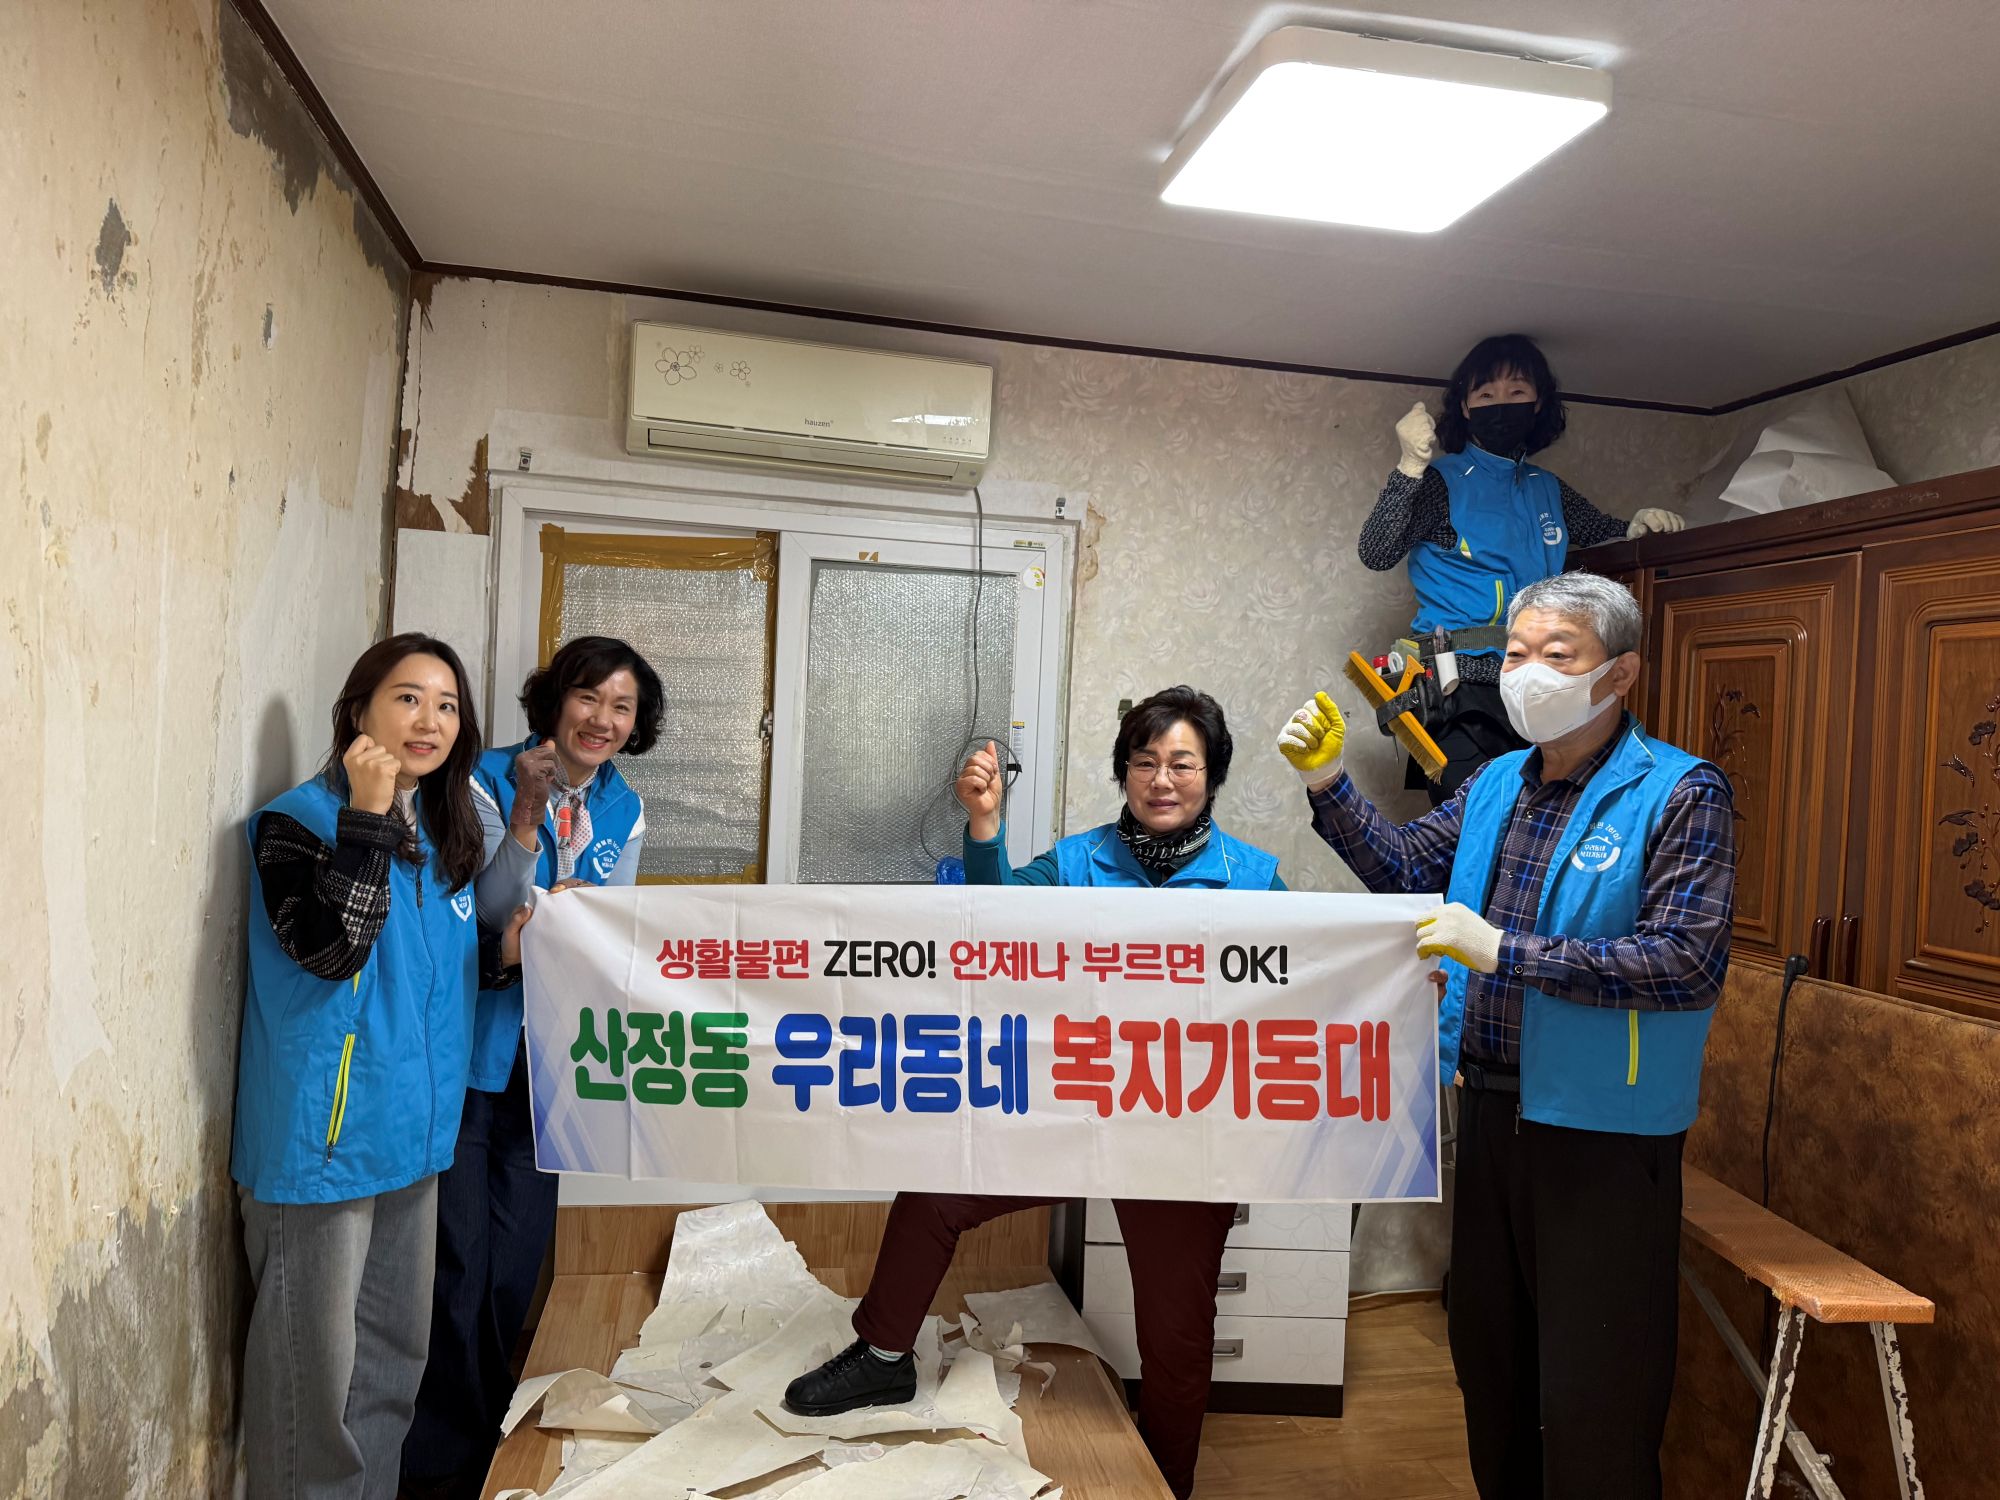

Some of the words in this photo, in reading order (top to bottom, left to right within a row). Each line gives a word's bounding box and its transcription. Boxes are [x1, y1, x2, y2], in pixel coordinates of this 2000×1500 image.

[656, 939, 809, 980] 생활불편
[823, 940, 936, 979] ZERO!
[949, 940, 1070, 982] 언제나
[1082, 943, 1205, 985] 부르면
[1219, 944, 1289, 985] OK!
[570, 1007, 750, 1108] 산정동
[772, 1013, 1029, 1115] 우리동네
[1051, 1014, 1391, 1122] 복지기동대
